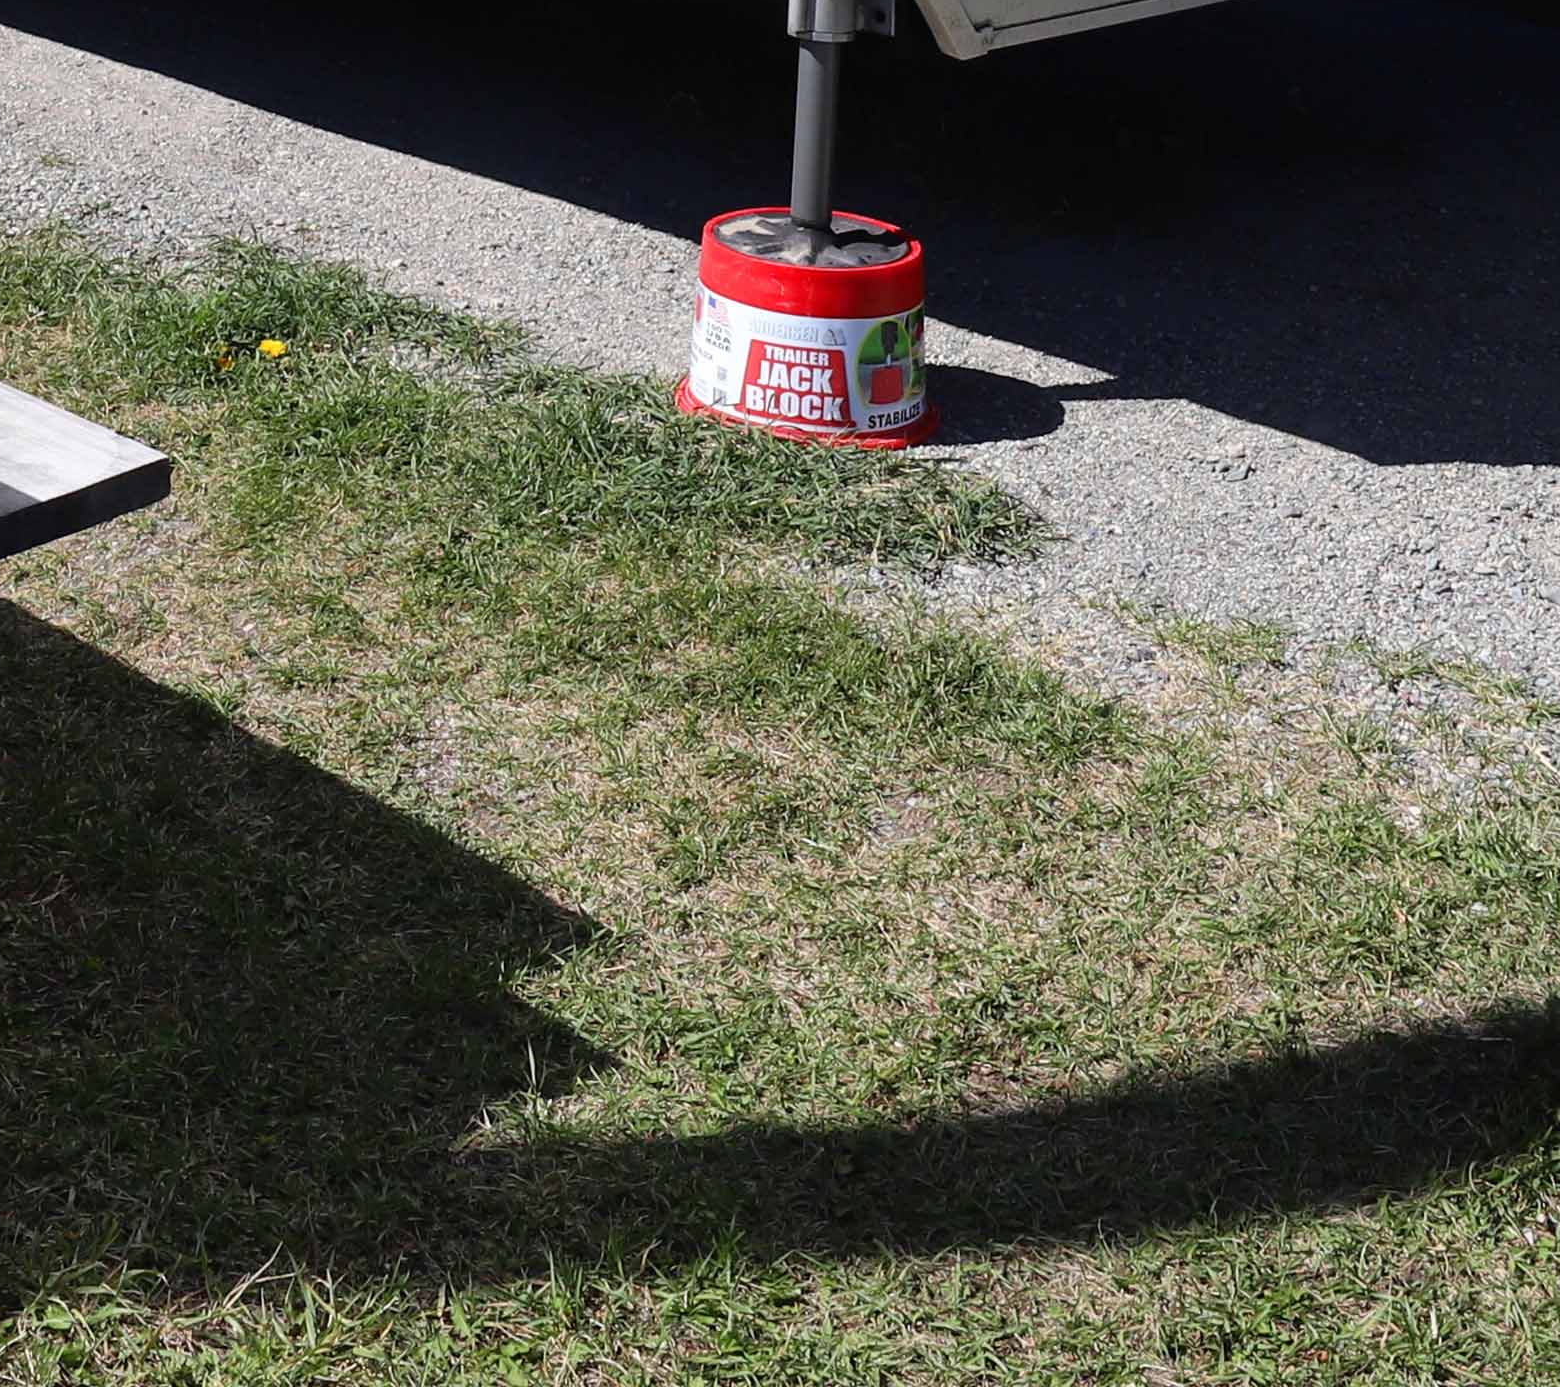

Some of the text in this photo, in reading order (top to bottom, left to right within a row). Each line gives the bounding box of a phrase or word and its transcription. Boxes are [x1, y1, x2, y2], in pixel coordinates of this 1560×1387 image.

[763, 344, 830, 367] TRAILER
[756, 364, 833, 392] JACK
[744, 384, 846, 421] BLOCK
[868, 403, 921, 430] STABILIZE
